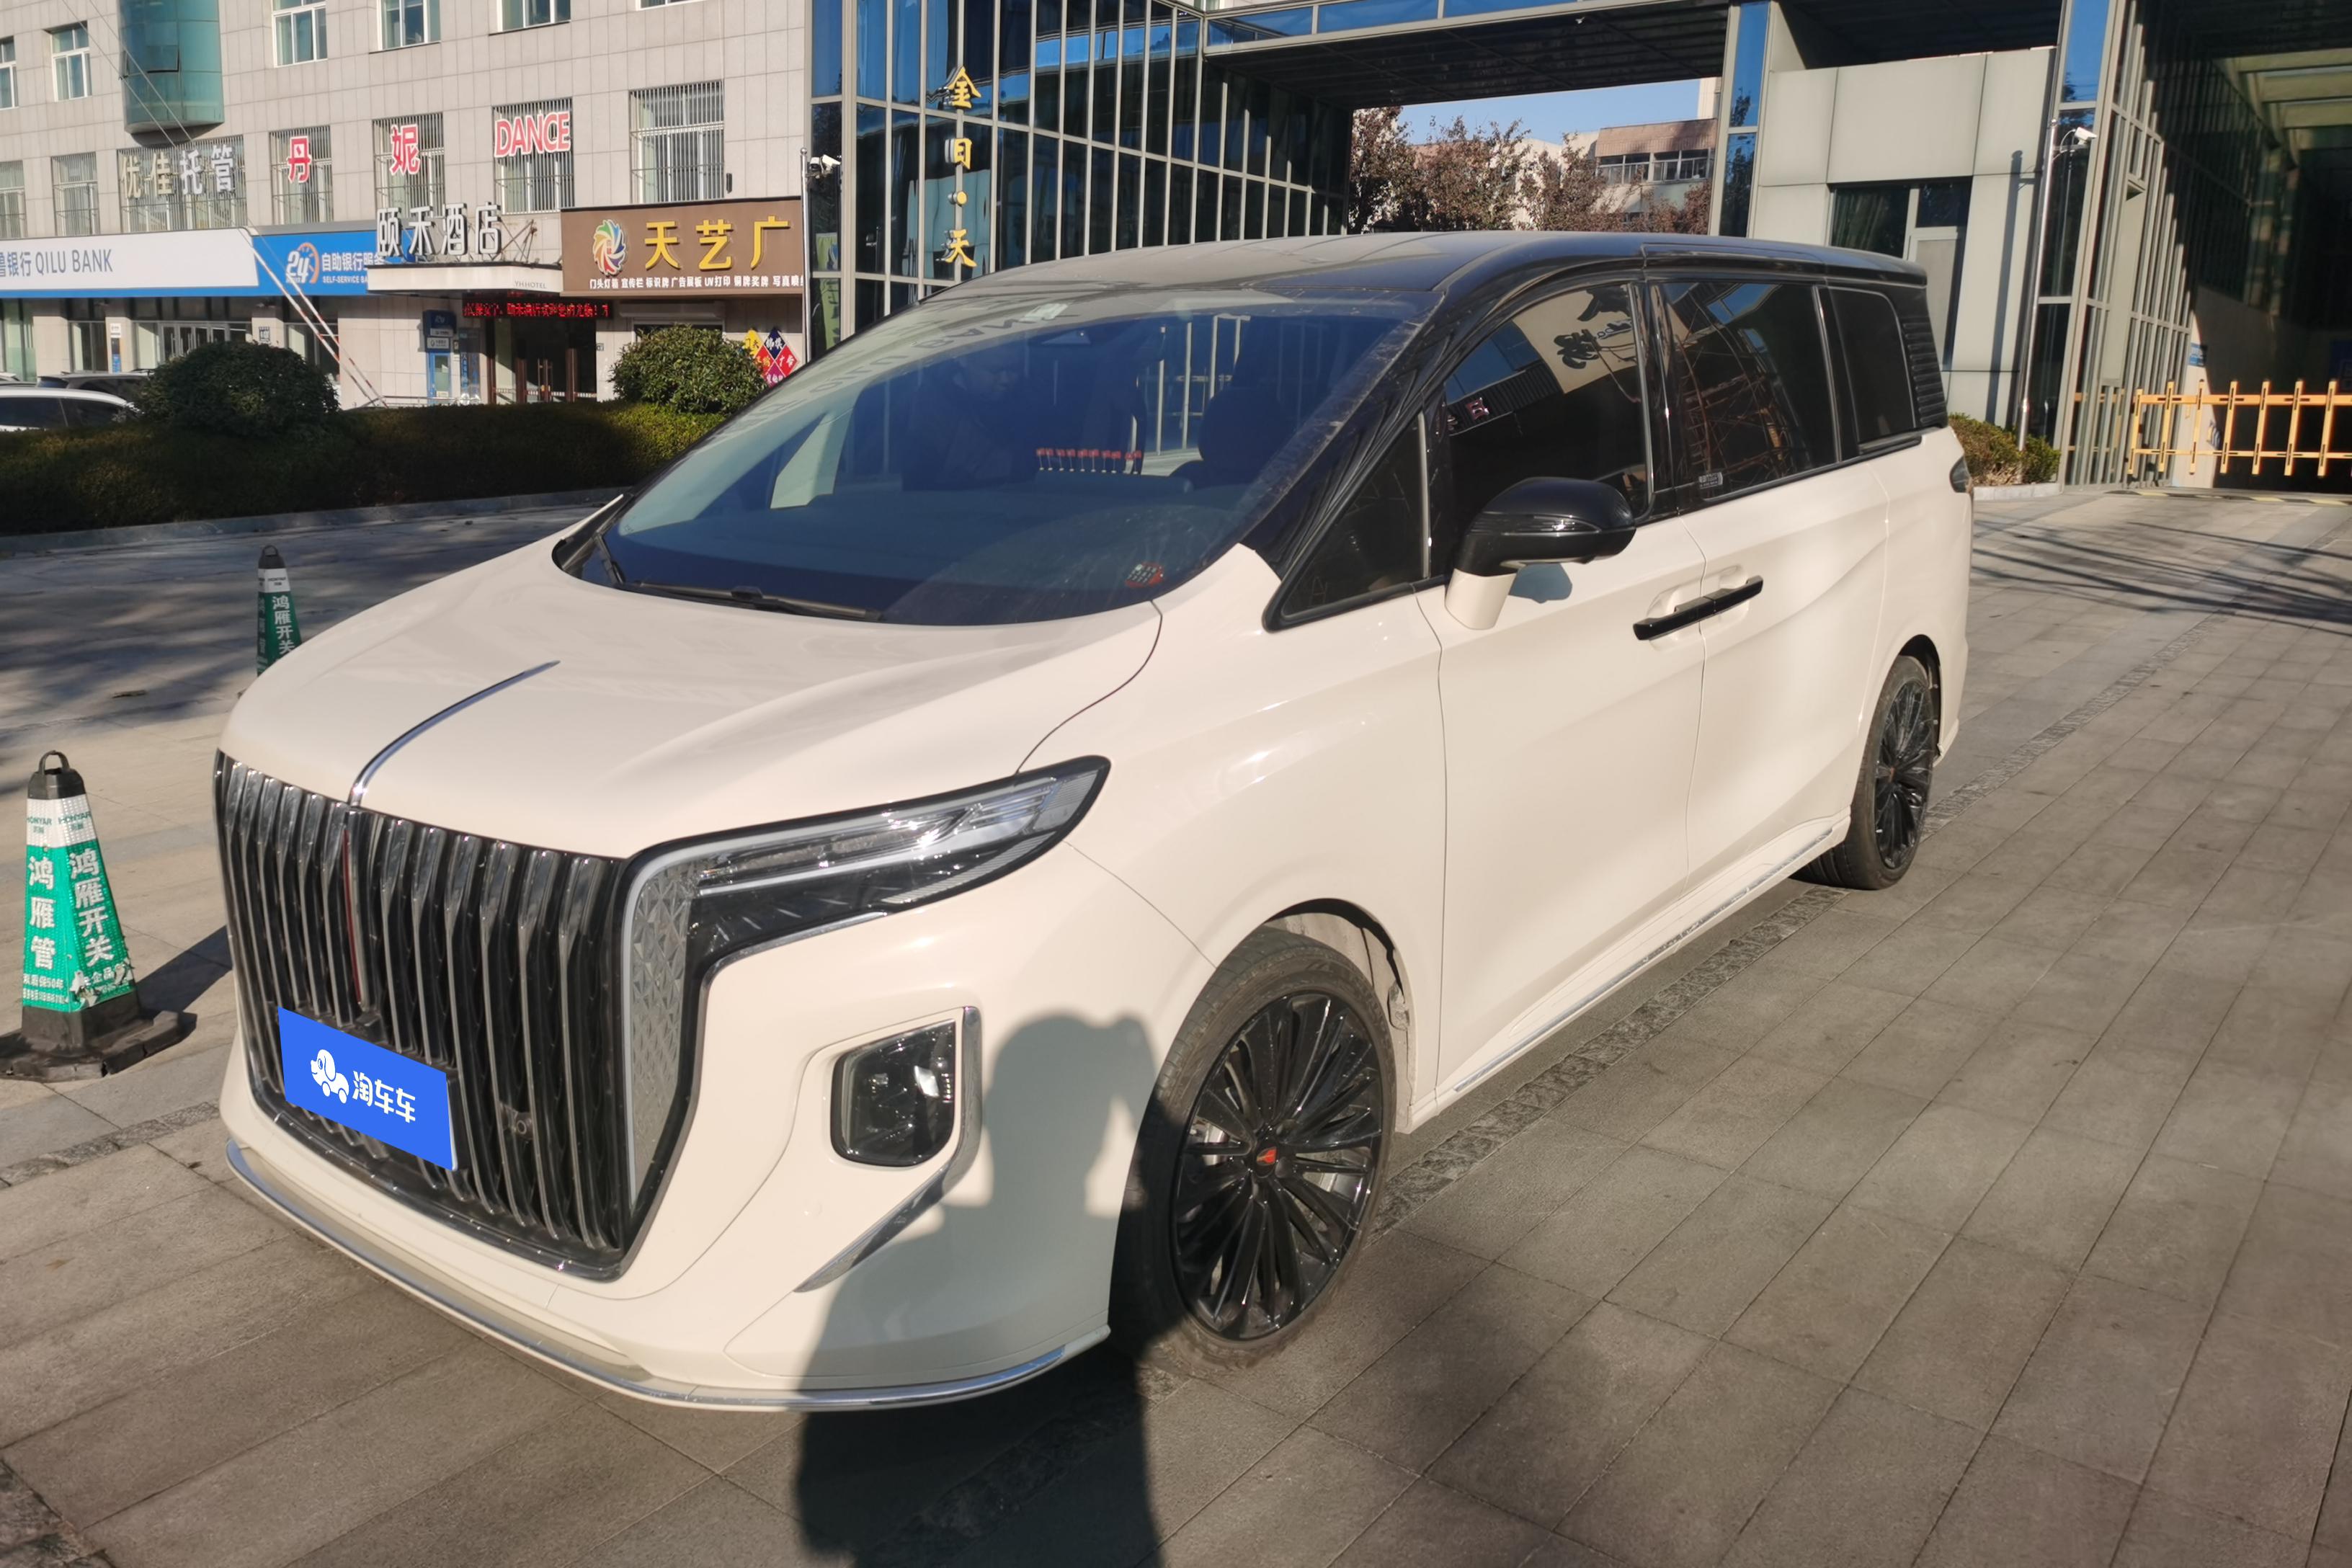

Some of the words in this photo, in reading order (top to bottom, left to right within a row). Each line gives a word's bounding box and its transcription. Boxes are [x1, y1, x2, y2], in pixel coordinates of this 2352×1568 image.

[121, 144, 235, 199] 优佳托管
[287, 135, 311, 183] 丹
[390, 123, 420, 175] 妮
[494, 110, 571, 158] DANCE
[376, 201, 503, 258] 颐禾酒店
[644, 215, 791, 271] 天艺广
[35, 251, 66, 276] QILU
[72, 249, 113, 273] BANK
[28, 856, 56, 970] 鸿雁管
[68, 847, 115, 968] 鸿雁开关
